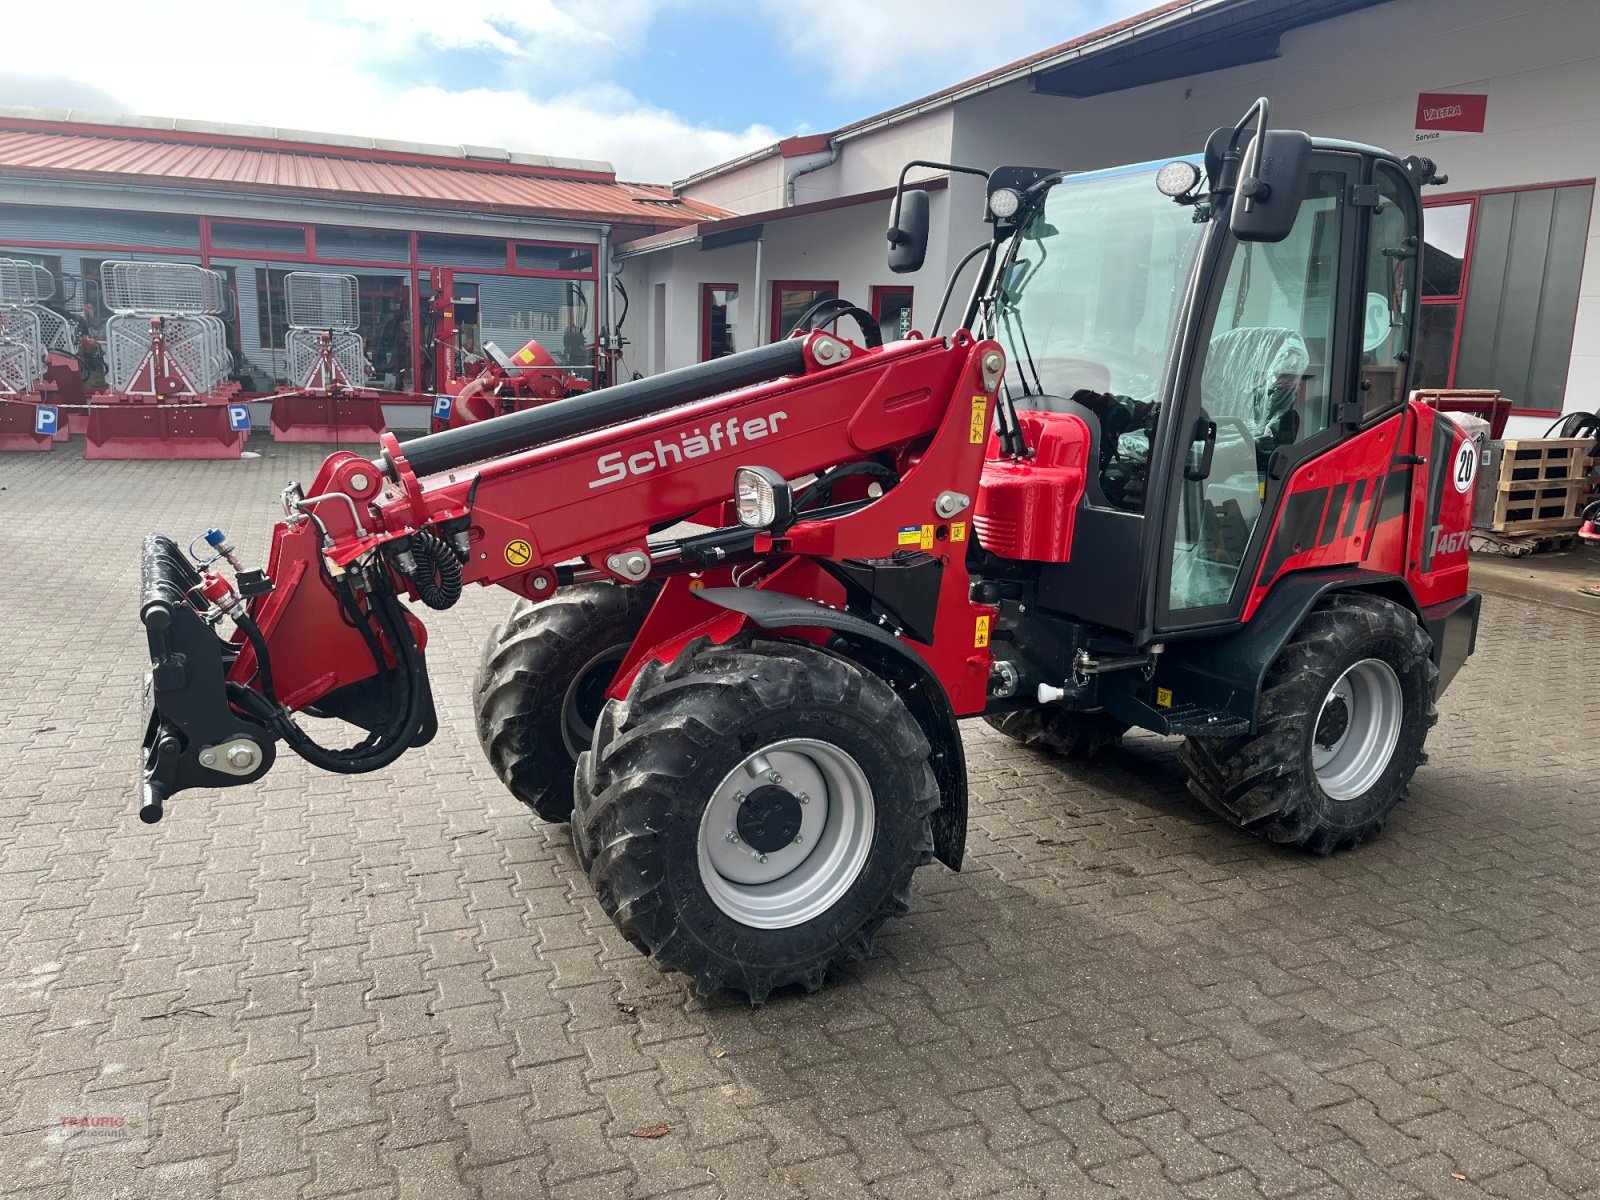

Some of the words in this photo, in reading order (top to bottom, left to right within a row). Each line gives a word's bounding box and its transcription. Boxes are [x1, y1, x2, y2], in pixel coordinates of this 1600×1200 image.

[1424, 105, 1461, 121] VALTRA
[1415, 132, 1440, 141] Service
[435, 397, 450, 413] P
[37, 410, 56, 429] P
[229, 407, 247, 426] P
[588, 411, 788, 488] Schäffer
[1457, 450, 1474, 482] 20
